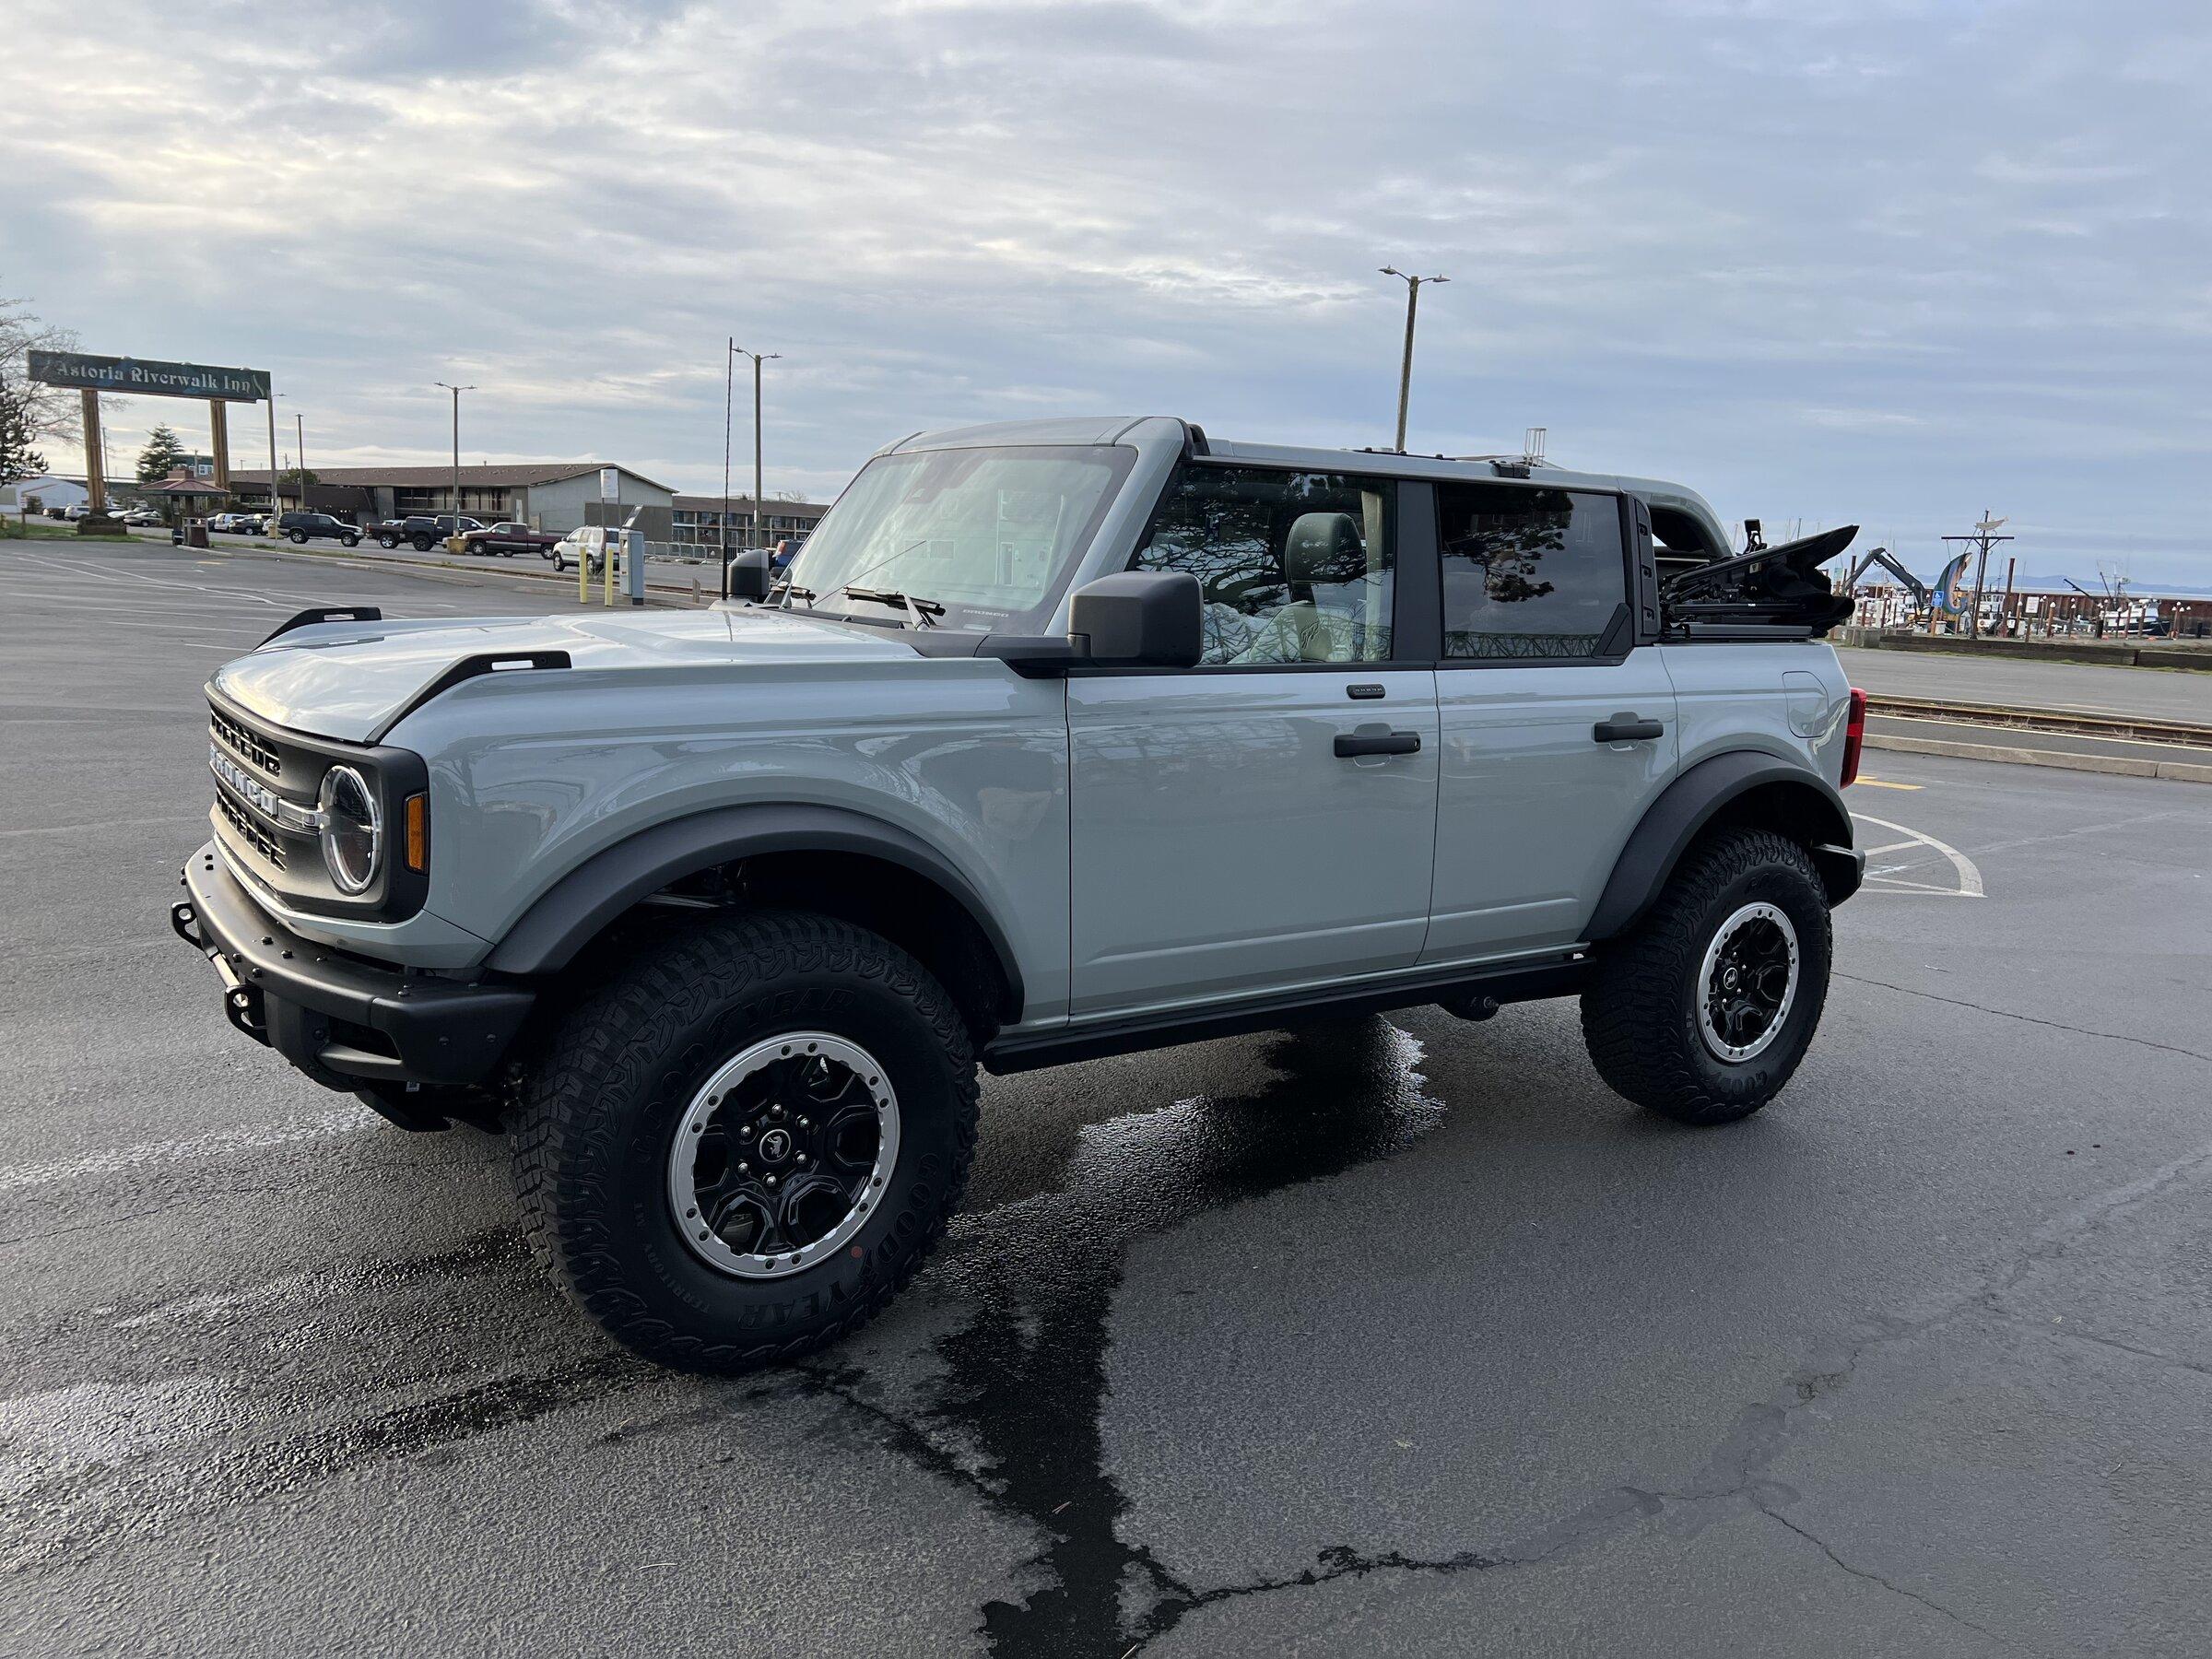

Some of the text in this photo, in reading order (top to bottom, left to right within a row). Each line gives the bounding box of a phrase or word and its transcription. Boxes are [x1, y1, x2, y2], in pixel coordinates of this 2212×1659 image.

[57, 364, 252, 394] Astoria Riverwalk Inn
